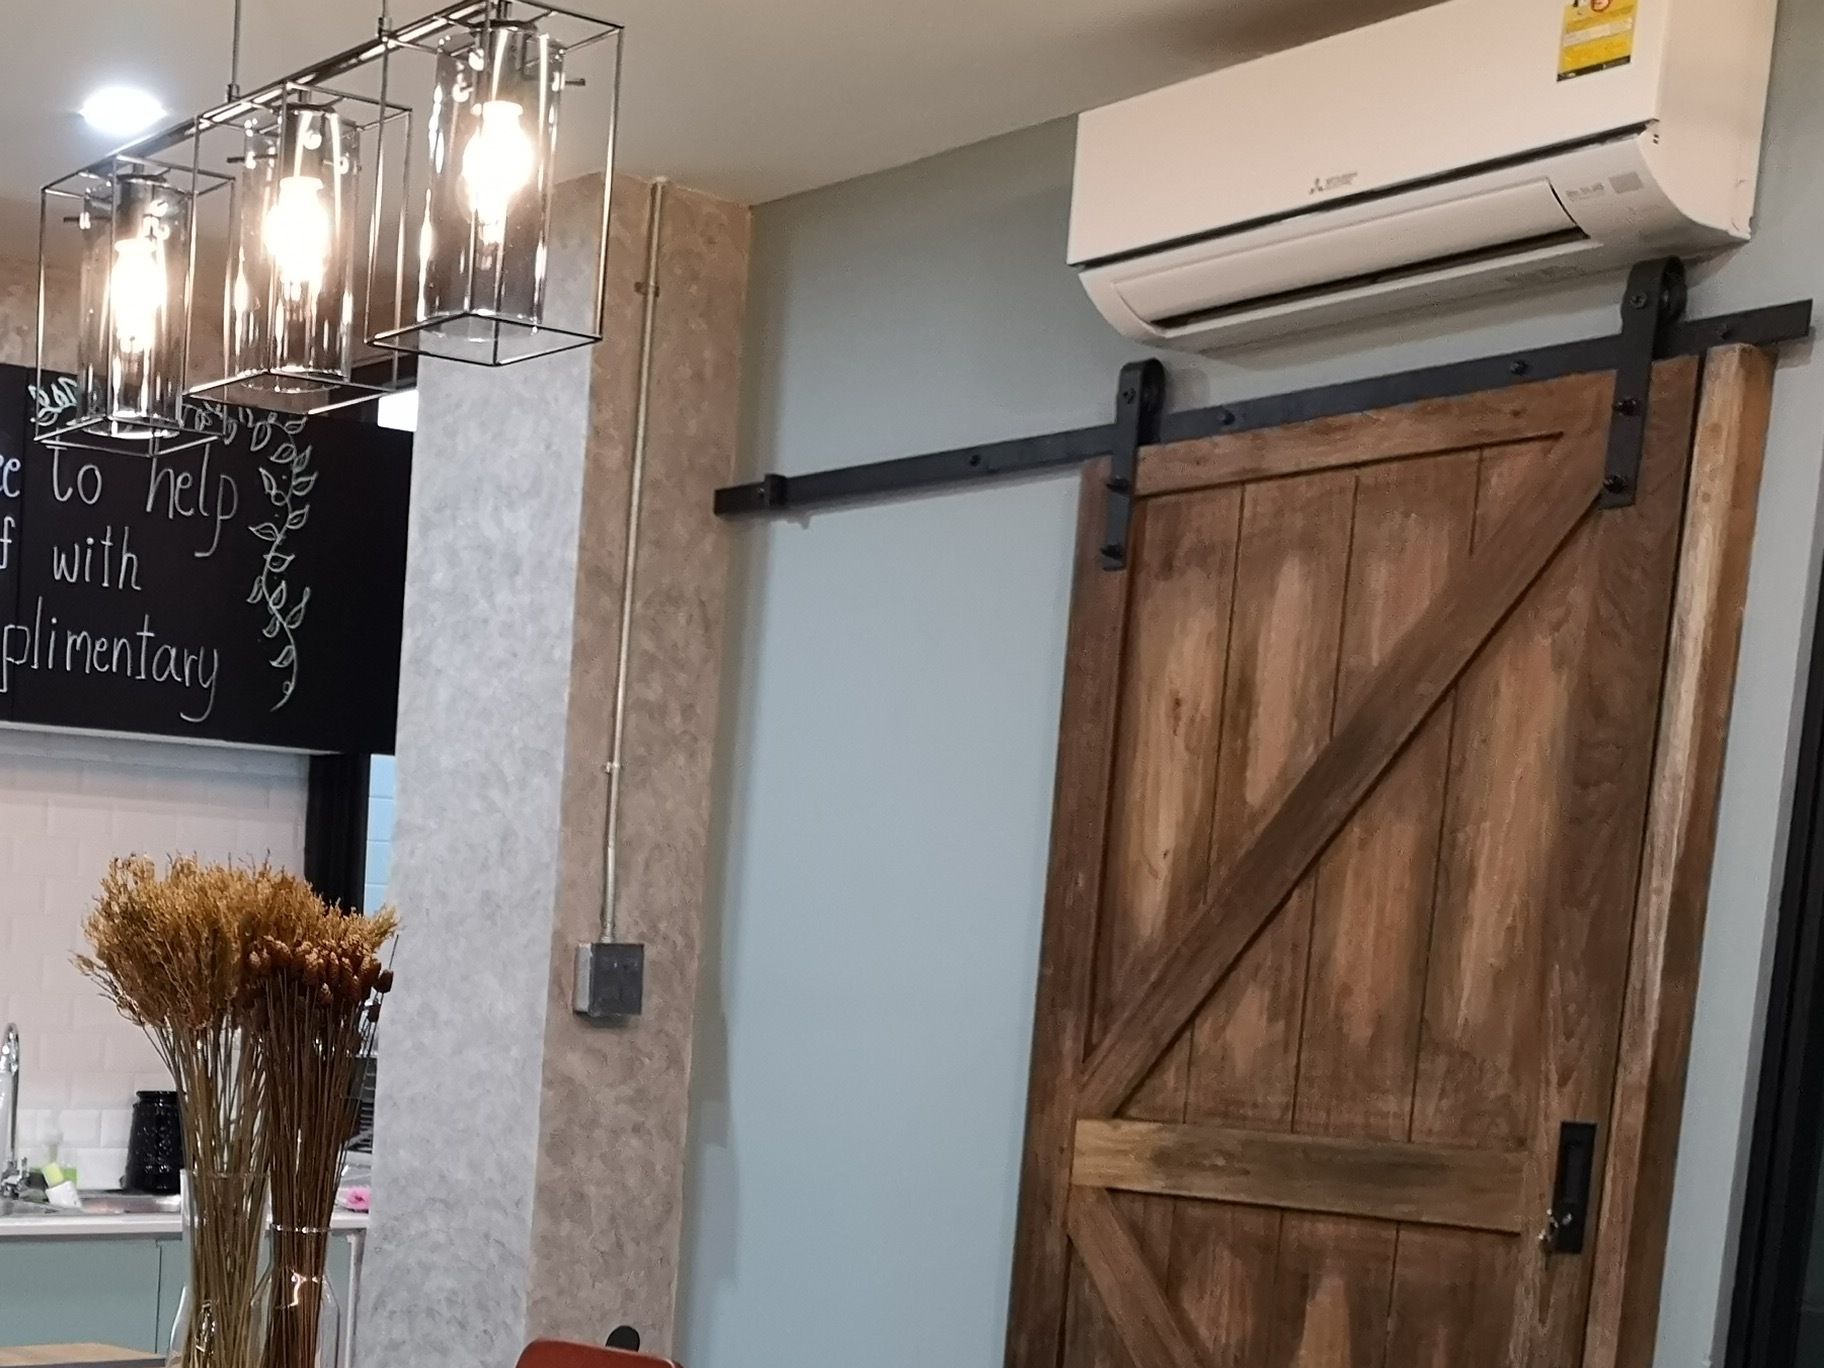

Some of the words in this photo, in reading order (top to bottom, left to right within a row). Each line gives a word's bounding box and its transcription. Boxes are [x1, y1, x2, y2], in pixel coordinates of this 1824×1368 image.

[46, 428, 102, 504] to
[146, 443, 238, 557] help
[53, 526, 141, 590] with
